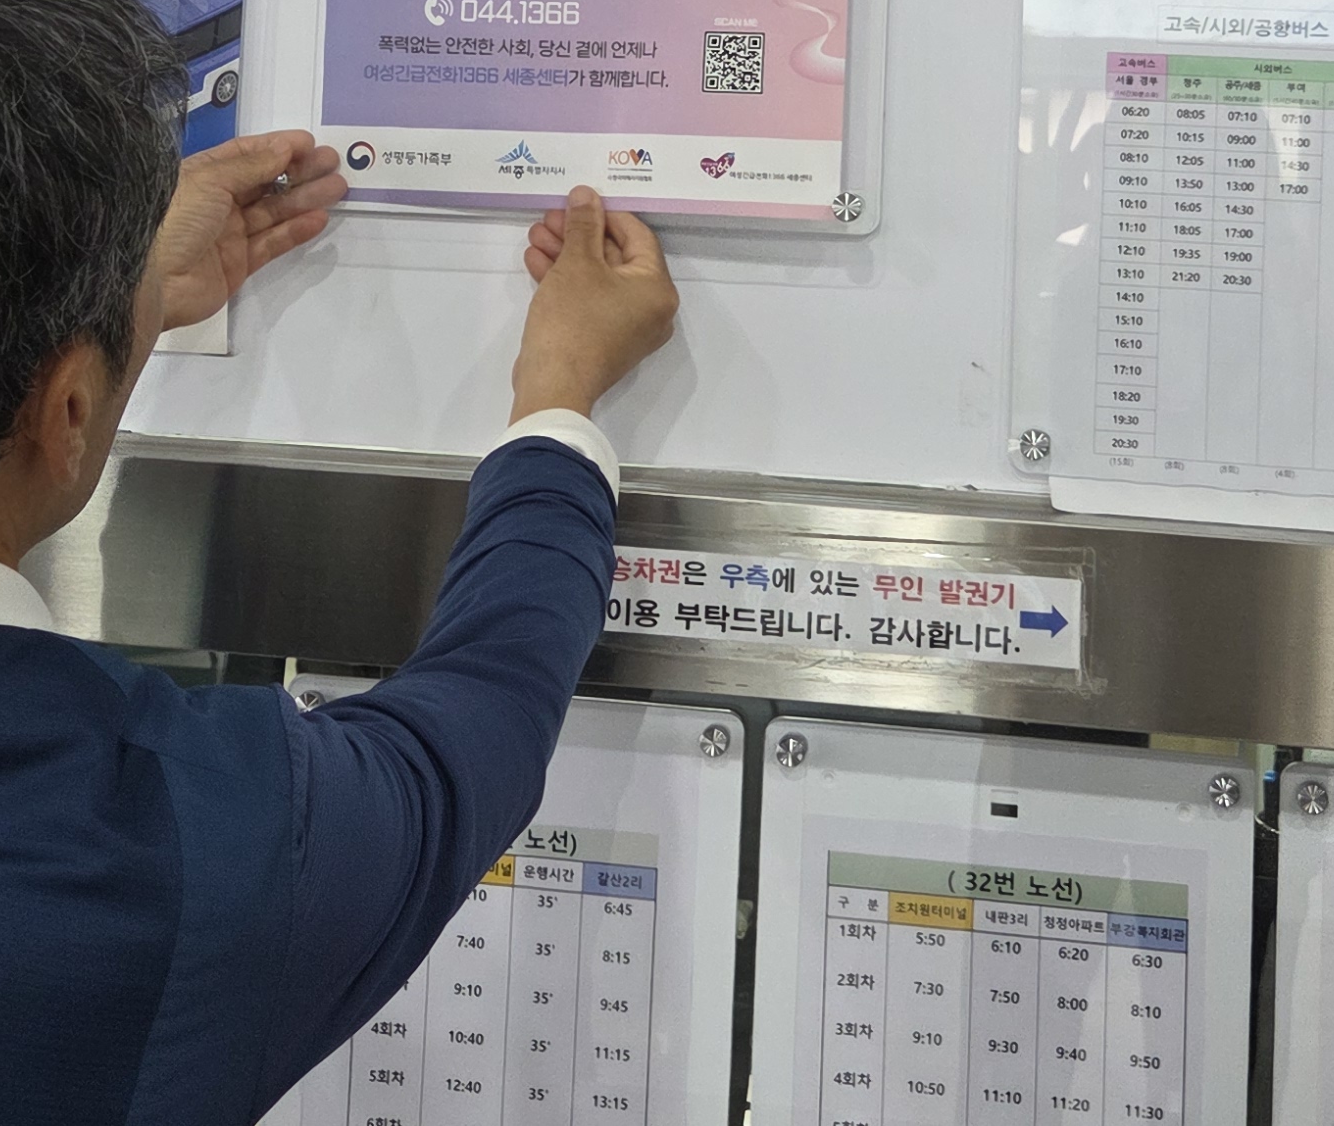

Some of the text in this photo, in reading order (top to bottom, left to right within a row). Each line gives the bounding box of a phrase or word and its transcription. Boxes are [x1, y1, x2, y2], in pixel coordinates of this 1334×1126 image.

[460, 0, 580, 25] 044.1366
[1163, 16, 1330, 39] 고속/시외/공항버스
[378, 35, 658, 59] 폭력없는 안전한 사회, 당신 곁에 언제나
[364, 64, 669, 88] 여성긴급전화1366 세종센터가 함께합니다.
[1121, 106, 1150, 118] 06:20
[1176, 108, 1206, 120] 08:05
[1227, 110, 1258, 123] 07:10
[1282, 113, 1312, 125] 07:10
[1120, 128, 1257, 146] 07:20 10:15 09:00
[609, 148, 653, 166] KOVA
[1115, 314, 1144, 327] 15:10
[1111, 437, 1139, 450] 20:30
[719, 563, 796, 594] 우측에
[809, 569, 860, 598] 있는
[872, 574, 923, 602] 무인
[939, 579, 1015, 610] 발권기
[603, 593, 1021, 656] 이용 부탁드립니다. 감사합니다.
[525, 829, 578, 856] 노선)
[523, 864, 575, 883] 운행시간
[597, 871, 643, 890] 갈산2리
[1026, 876, 1083, 905] 노선)
[603, 901, 633, 917] 6:45
[895, 901, 967, 921] 조치원터미널
[985, 910, 1028, 927] 내판3리
[1043, 915, 1105, 934] 청정아파트
[456, 934, 631, 965] 7:40 8:15
[839, 923, 1163, 969] 1회차 5:50 6:10 6:20 6:30
[453, 982, 629, 1013] 9:10 9:45
[370, 1021, 631, 1062] 4회차 10:40 11:15
[833, 1071, 1164, 1121] 4회차 10:50 11:10 11:20 11:30
